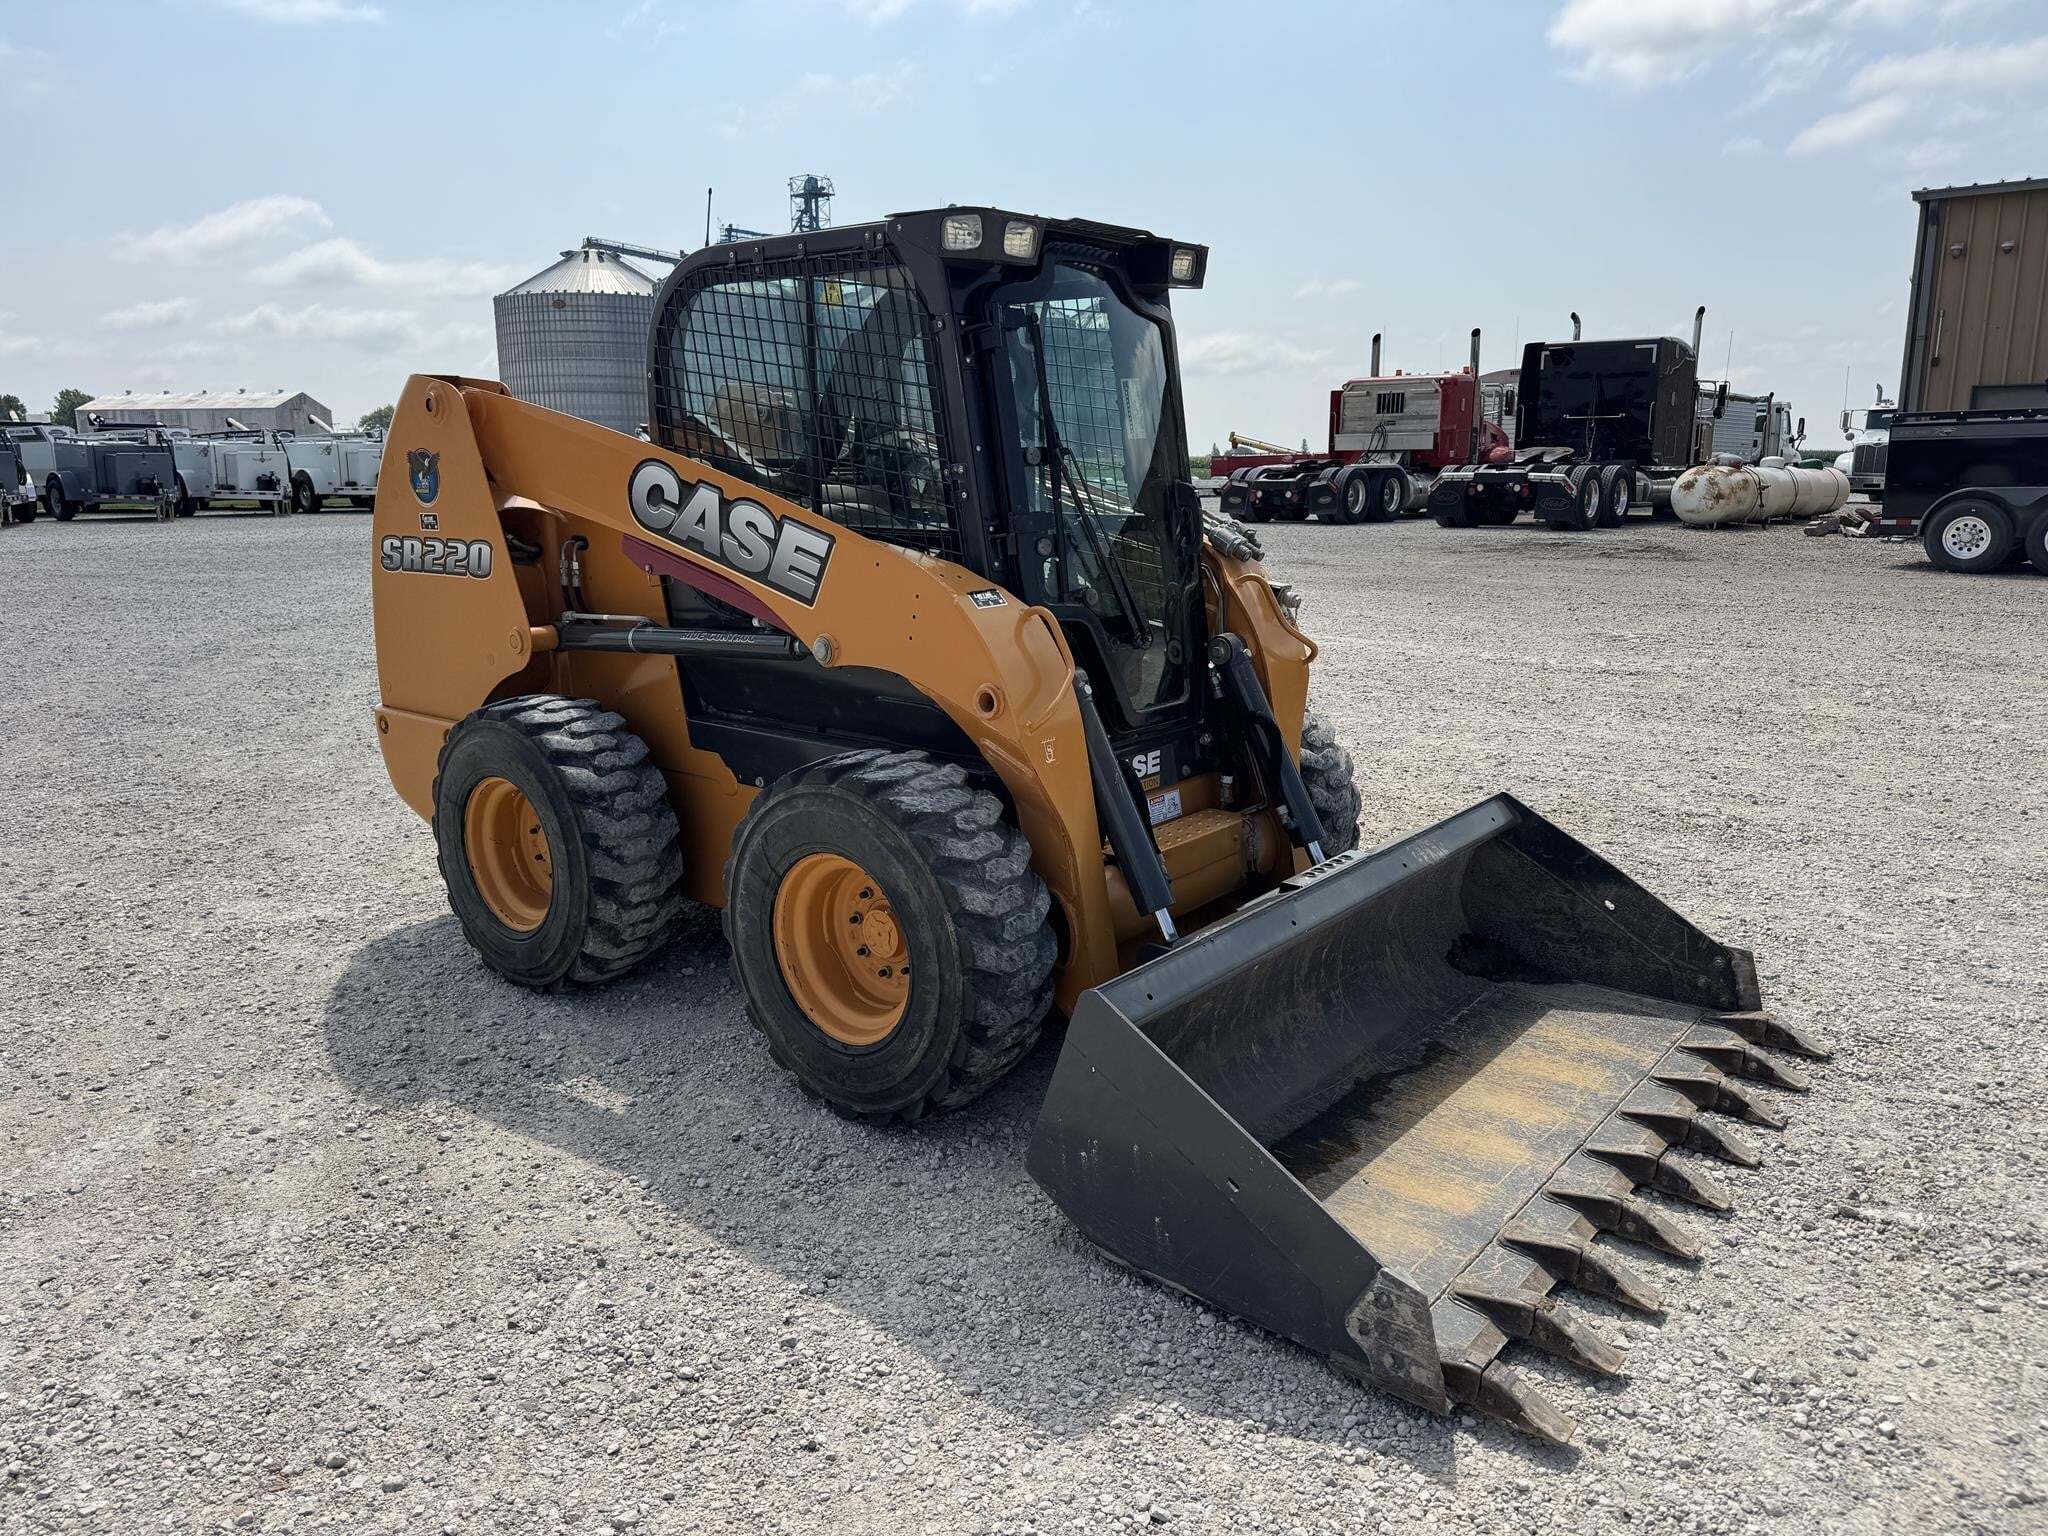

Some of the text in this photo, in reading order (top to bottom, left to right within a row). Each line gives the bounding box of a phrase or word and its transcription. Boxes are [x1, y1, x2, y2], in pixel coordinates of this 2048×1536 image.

[629, 460, 834, 603] CASE
[381, 535, 493, 578] SR220
[1132, 749, 1161, 778] SE
